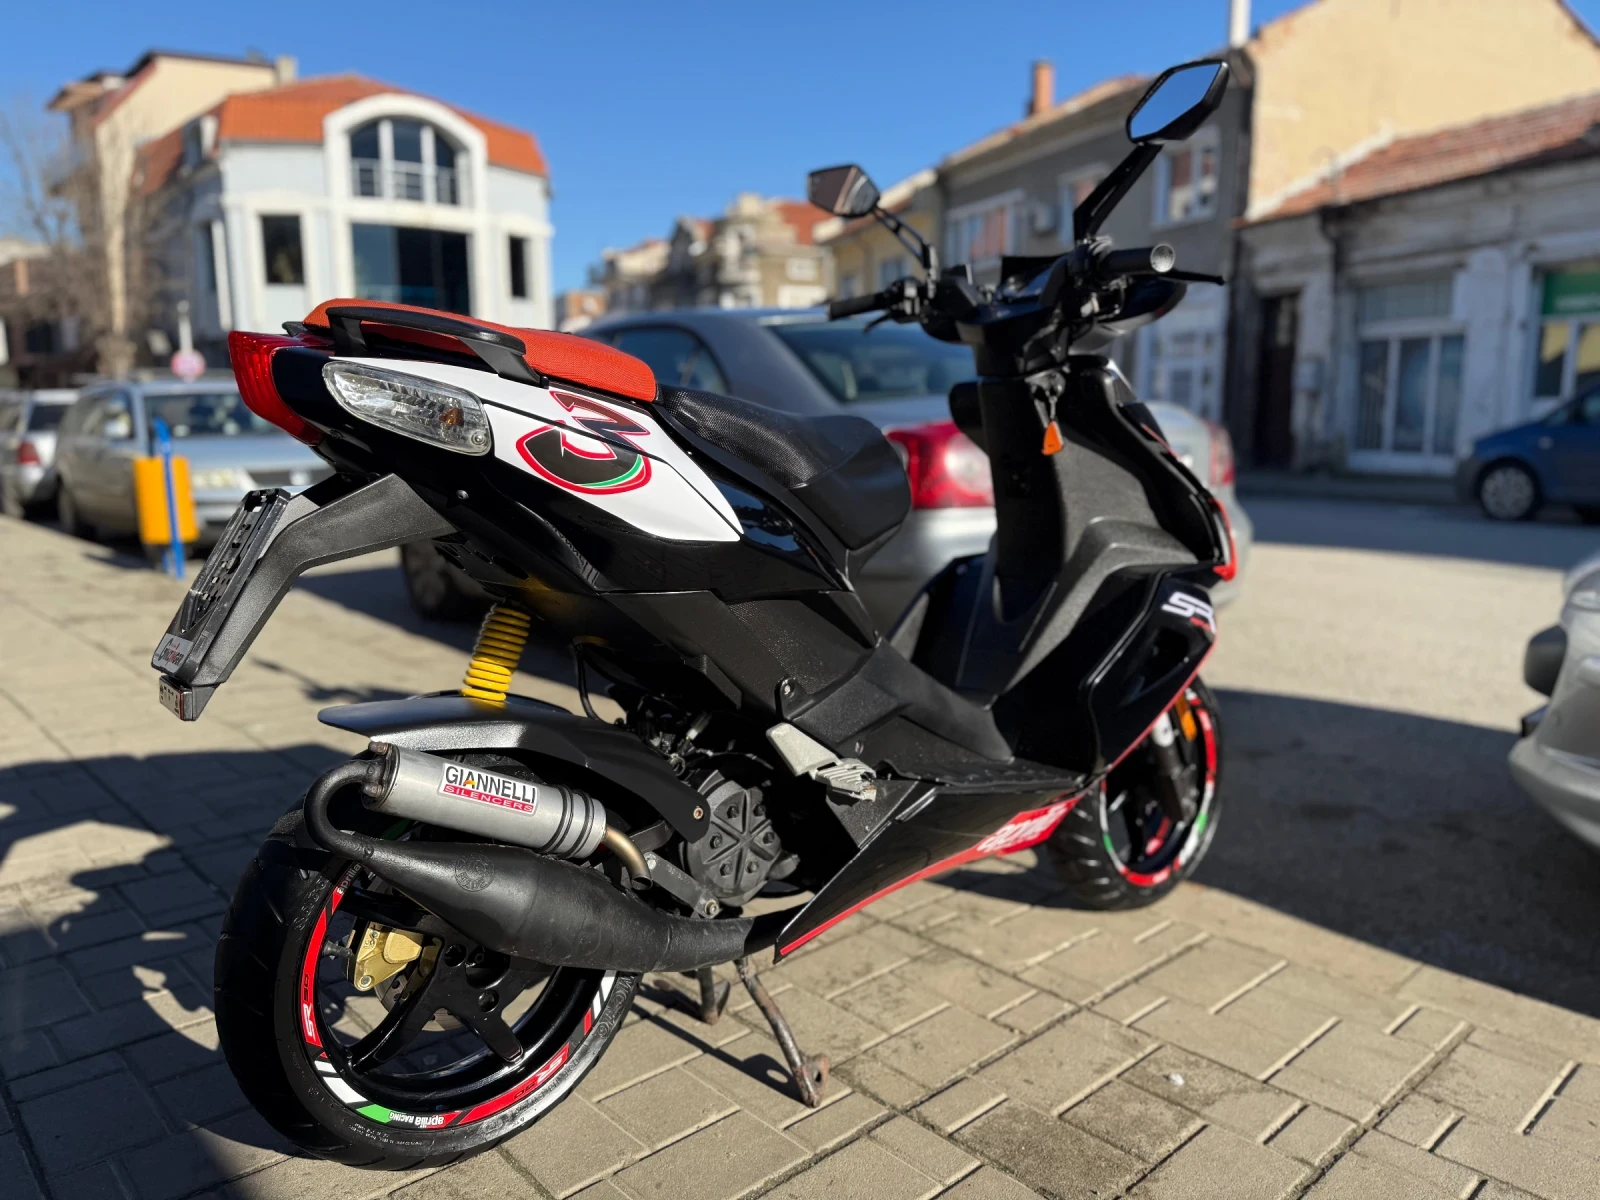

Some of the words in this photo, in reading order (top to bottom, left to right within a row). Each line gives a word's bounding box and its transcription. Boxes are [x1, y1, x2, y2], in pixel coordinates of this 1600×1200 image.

[444, 785, 534, 812] SILENCERS
[445, 766, 536, 804] GIANNELLI
[336, 862, 362, 894] aprilia
[535, 1051, 569, 1085] SR
[389, 1111, 415, 1124] RACING
[414, 1114, 445, 1129] aprilia
